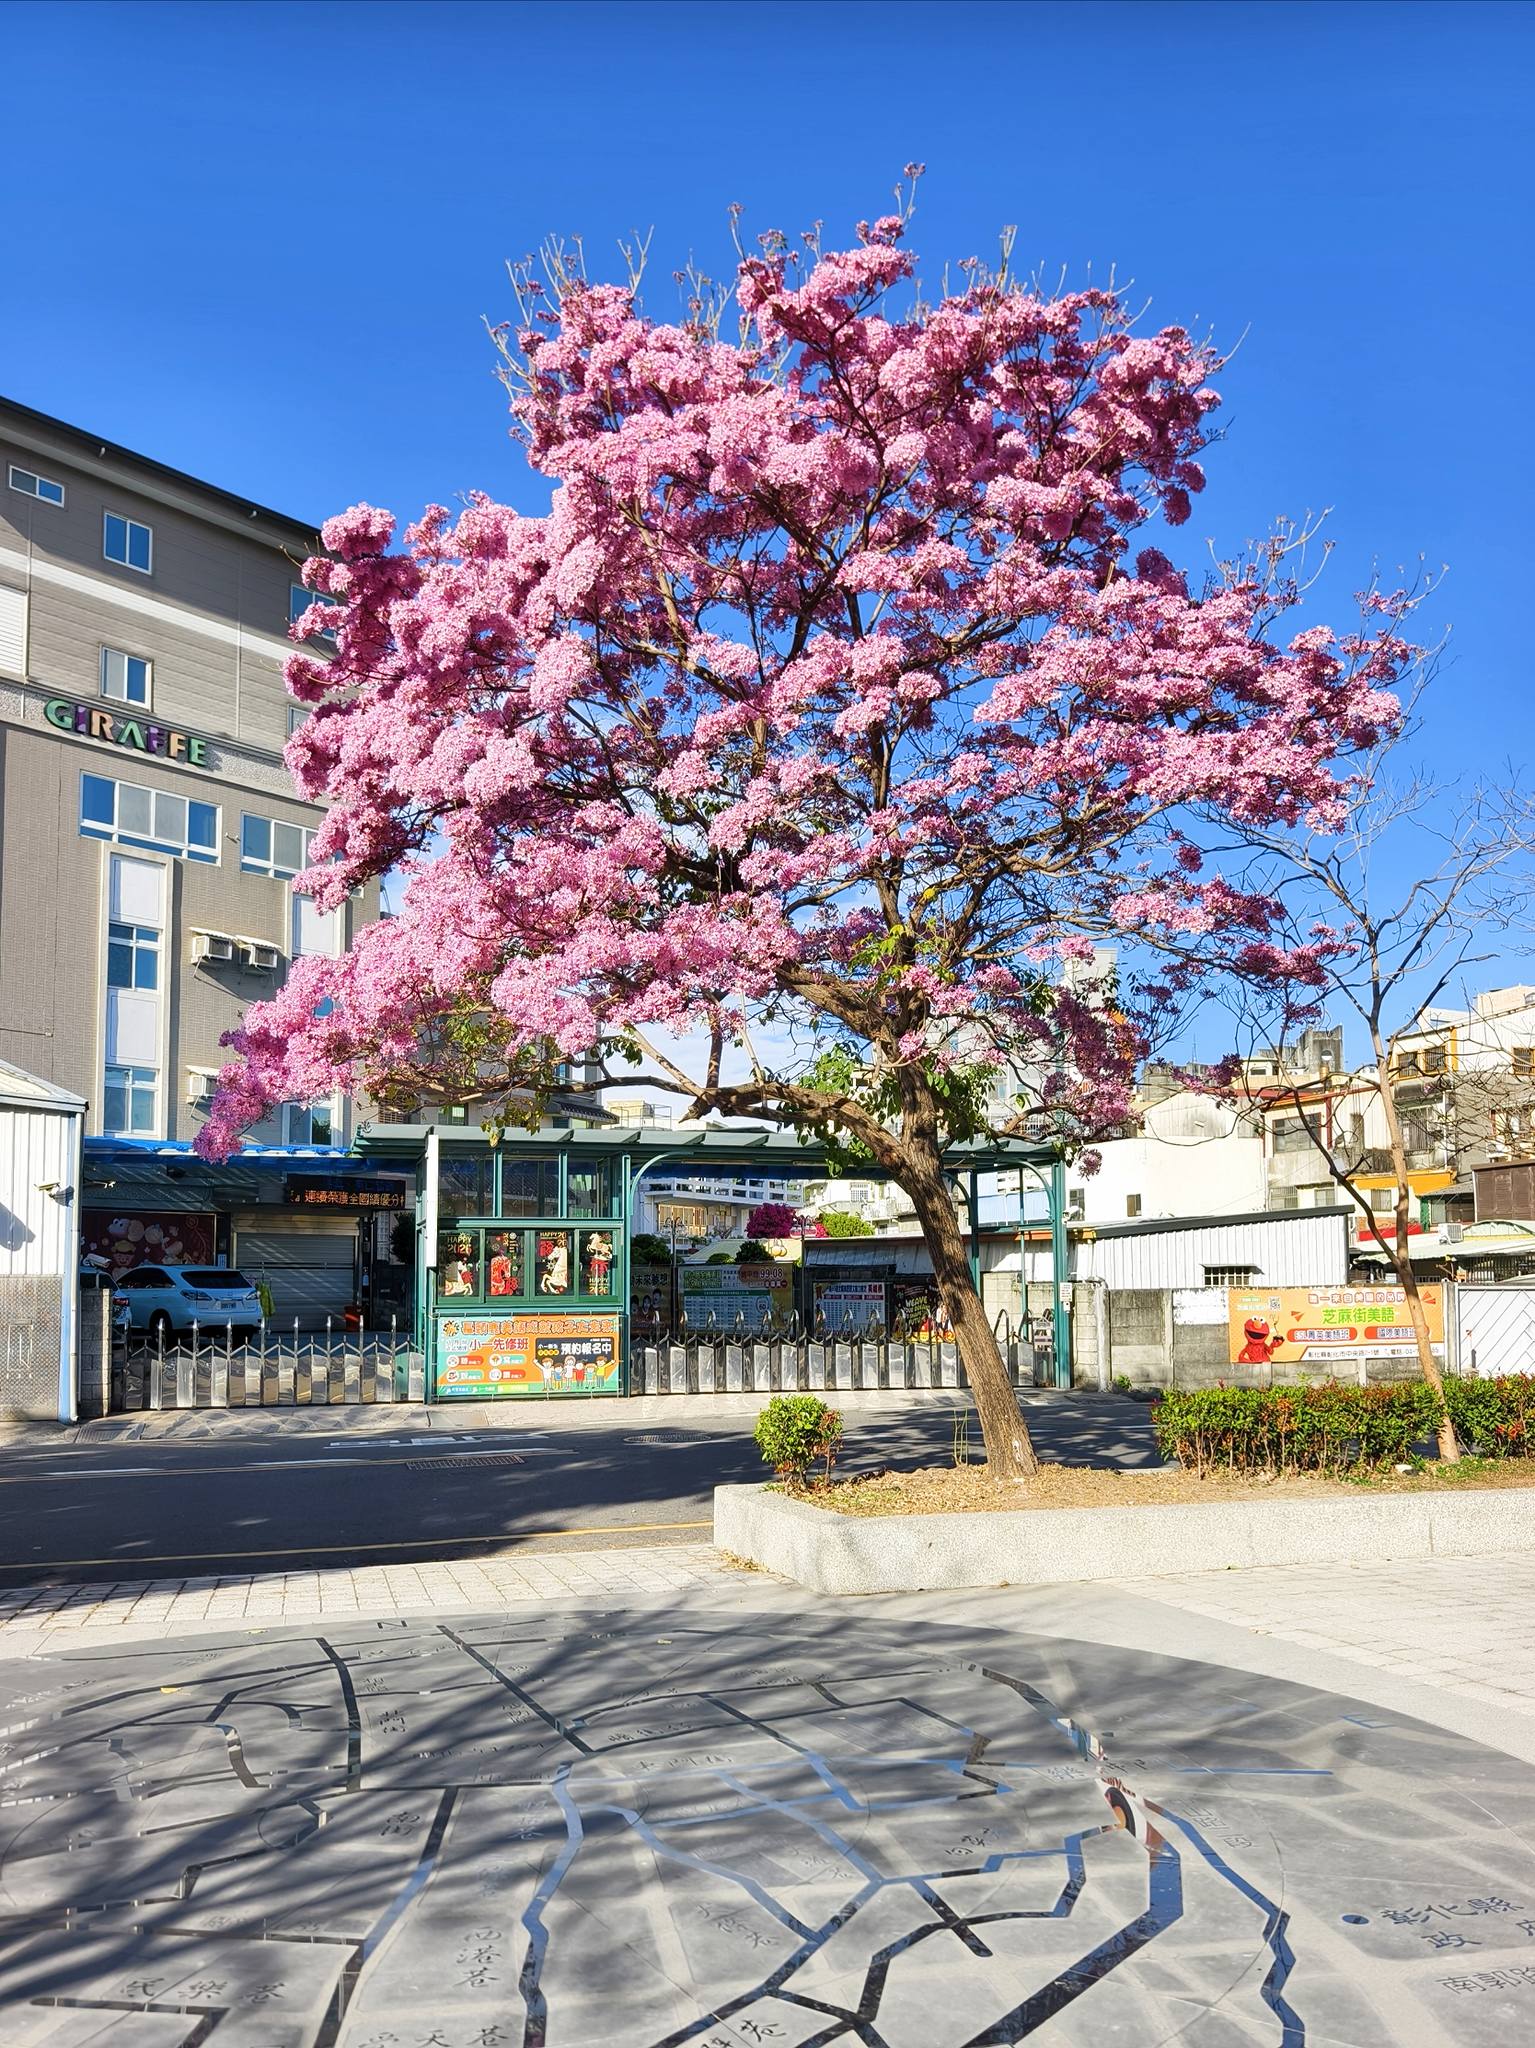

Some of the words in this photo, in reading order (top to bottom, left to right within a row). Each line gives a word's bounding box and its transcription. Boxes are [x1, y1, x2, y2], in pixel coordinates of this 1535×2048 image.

[44, 698, 207, 767] GIRAFFE
[447, 1236, 472, 1244] HAPPY
[447, 1244, 472, 1253] 2026
[1321, 1307, 1395, 1325] 芝麻街美語
[1380, 1896, 1524, 1925] 彰化縣
